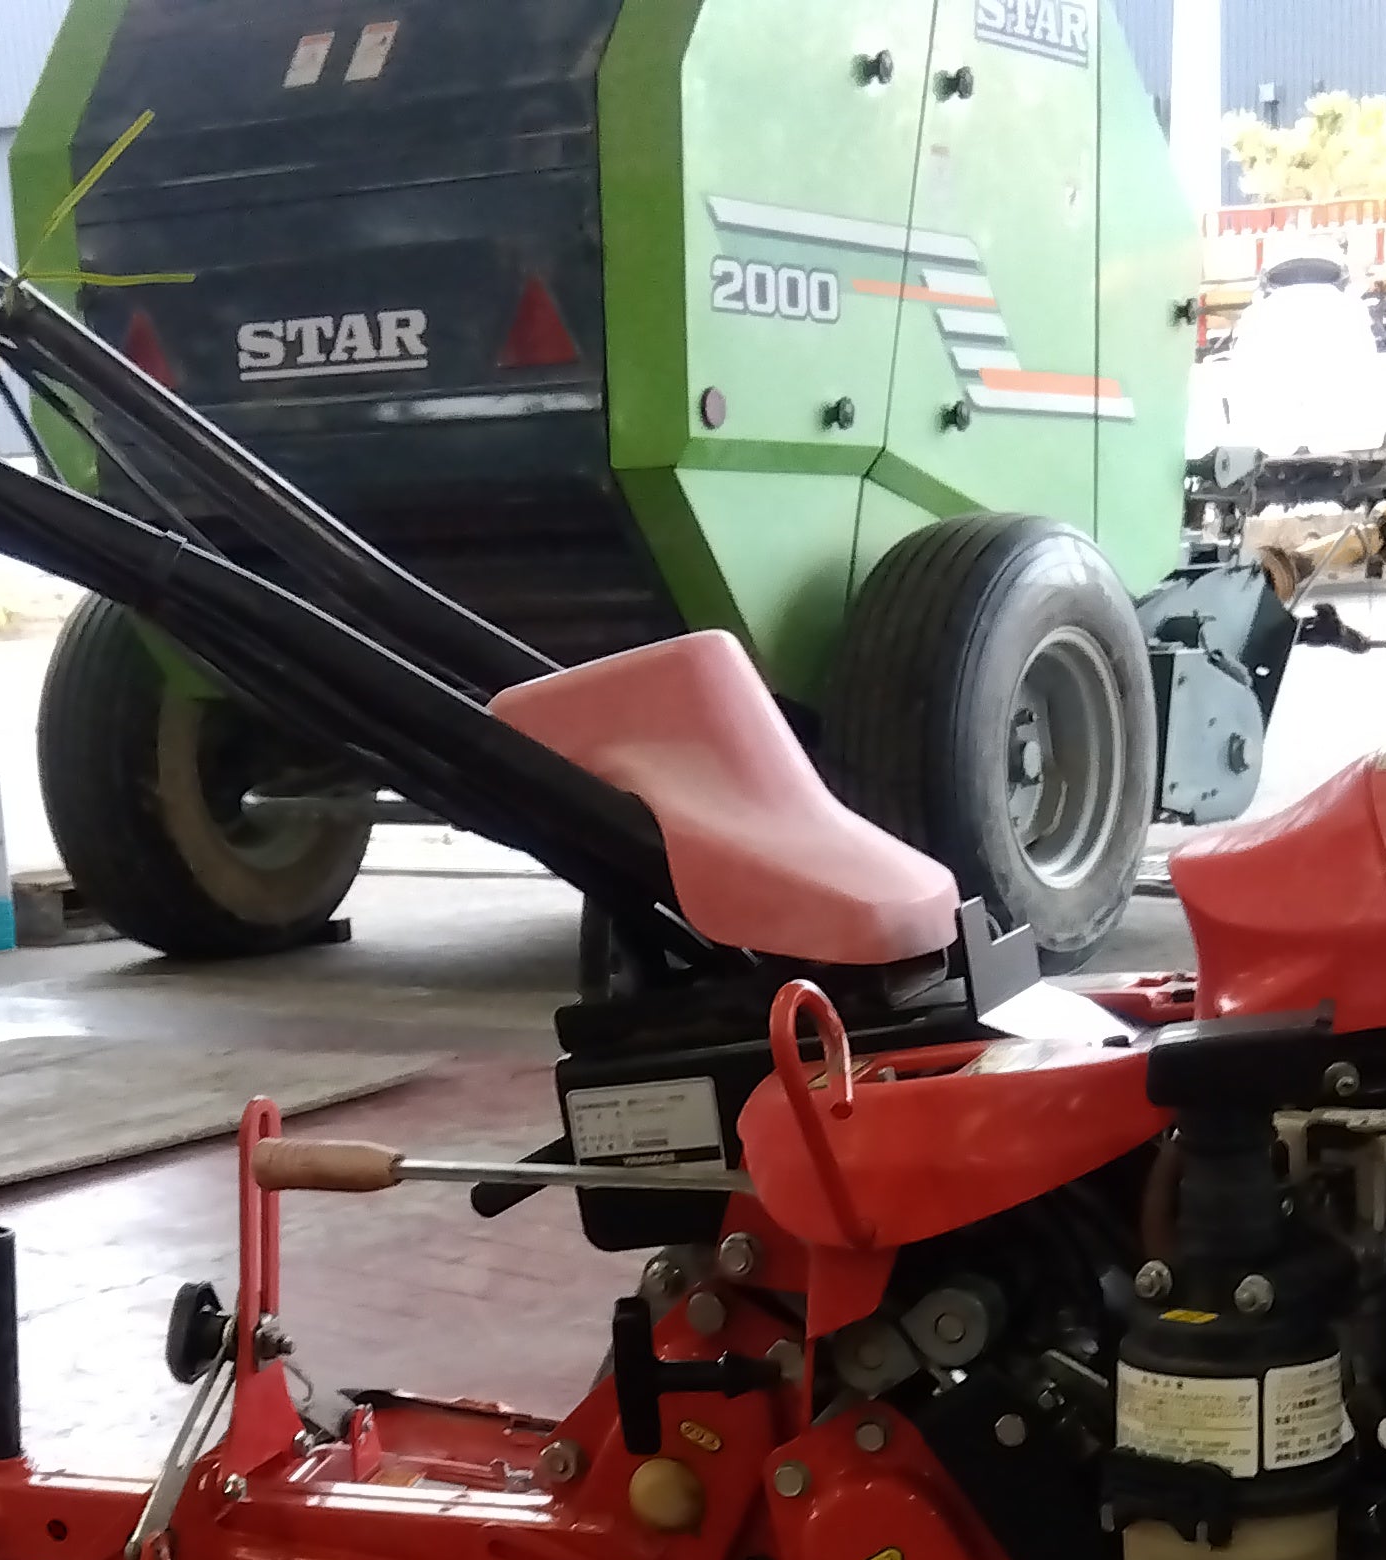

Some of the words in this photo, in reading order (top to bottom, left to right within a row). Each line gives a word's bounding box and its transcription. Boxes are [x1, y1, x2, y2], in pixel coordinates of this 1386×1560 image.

[975, 0, 1087, 56] STAR
[712, 256, 840, 323] 2000
[237, 309, 428, 370] STAR
